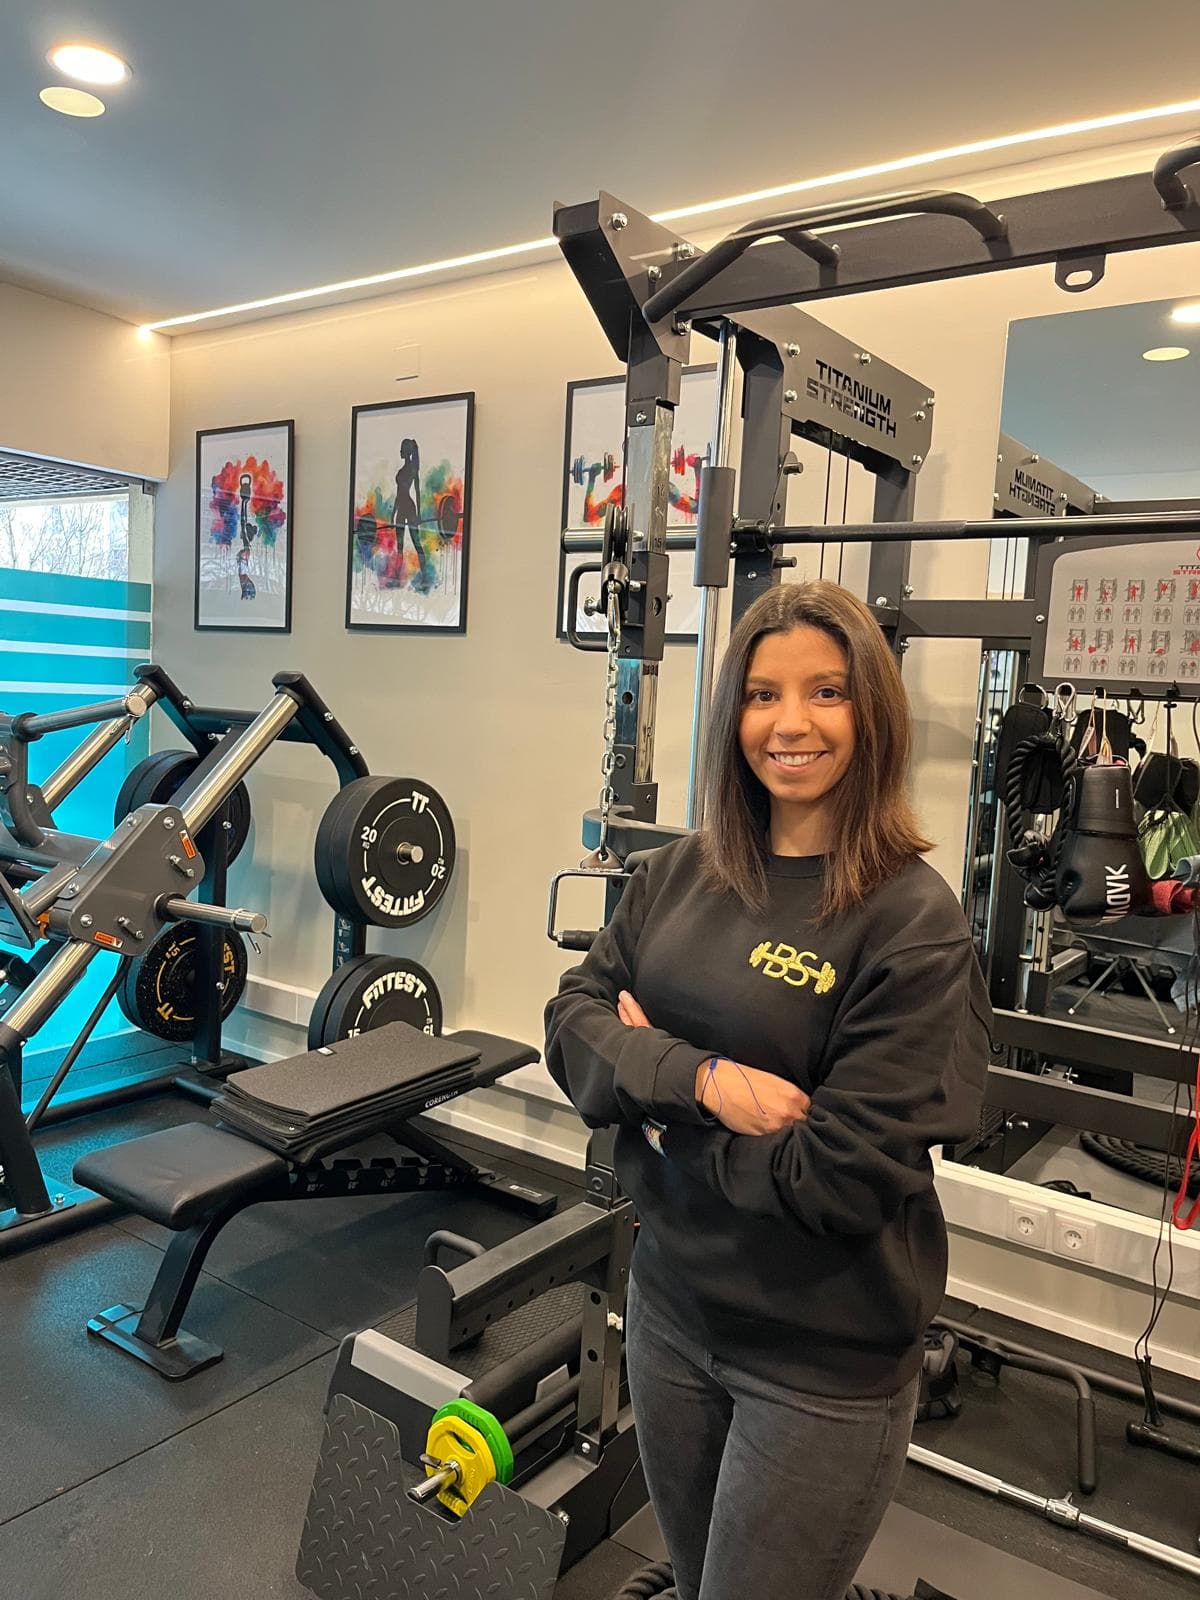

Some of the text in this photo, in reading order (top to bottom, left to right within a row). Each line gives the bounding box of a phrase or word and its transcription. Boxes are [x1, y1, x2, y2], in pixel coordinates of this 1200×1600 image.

[815, 358, 892, 416] TITANIUM
[806, 376, 897, 439] STRENGTH
[361, 825, 378, 844] 20
[361, 876, 425, 916] FITTEST
[362, 971, 428, 1010] FITTEST
